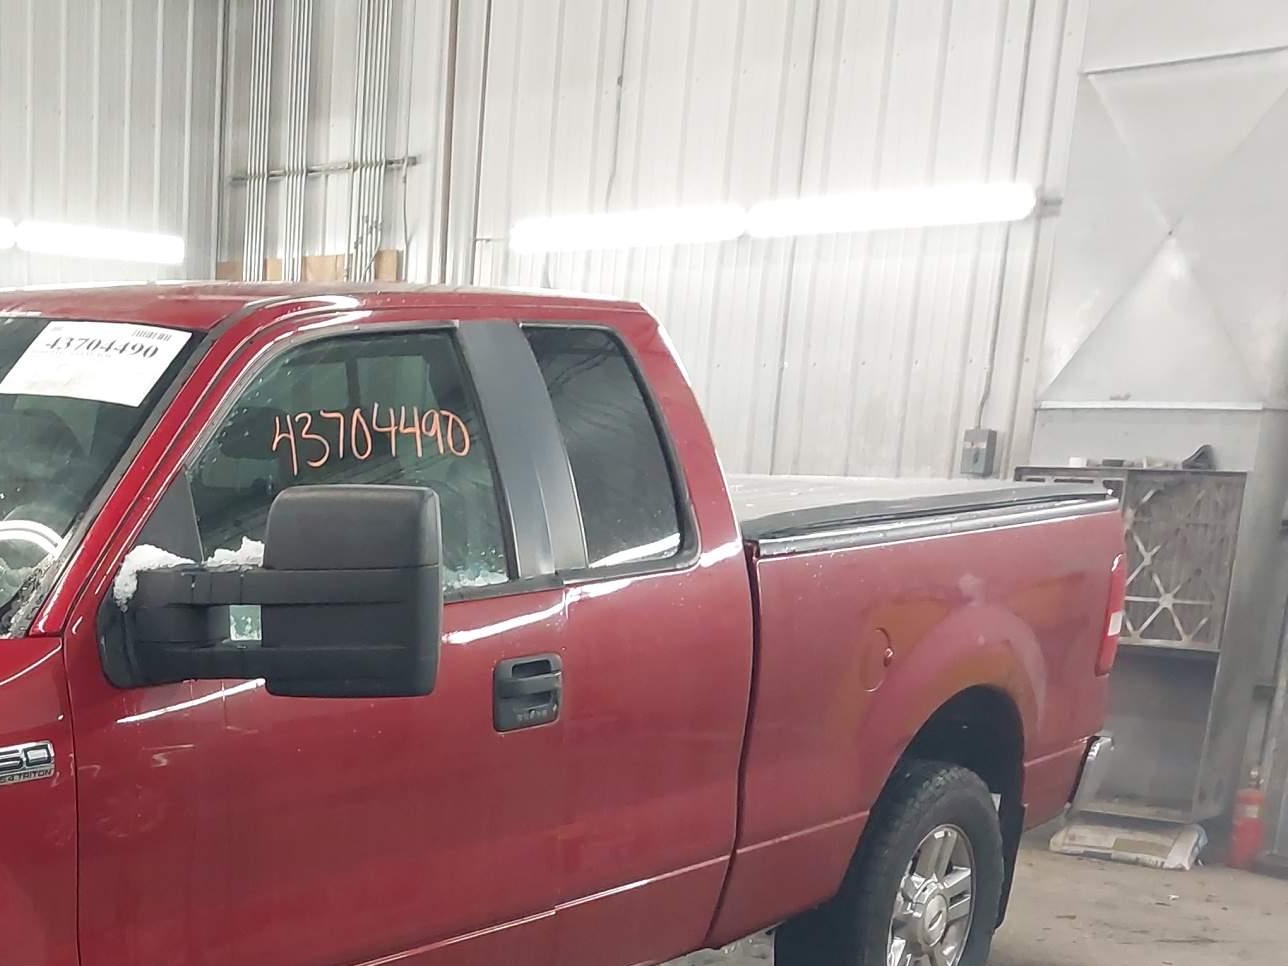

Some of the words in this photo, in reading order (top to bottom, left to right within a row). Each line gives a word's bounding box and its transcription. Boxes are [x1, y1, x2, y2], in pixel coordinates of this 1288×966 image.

[45, 335, 160, 359] 43704490
[271, 402, 471, 476] 43704490
[16, 769, 53, 781] TRITON
